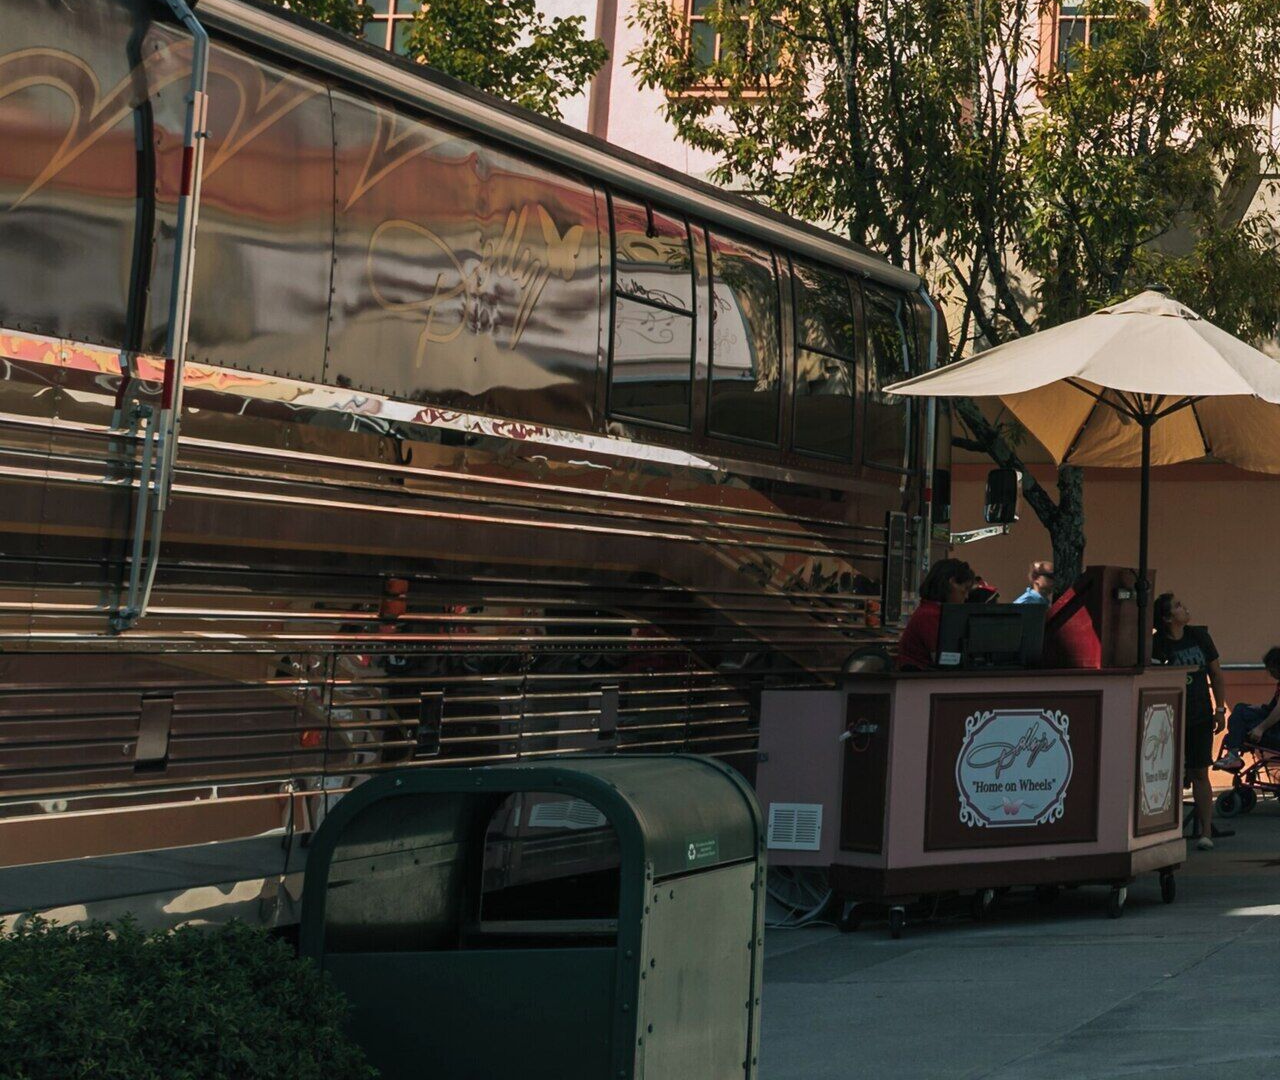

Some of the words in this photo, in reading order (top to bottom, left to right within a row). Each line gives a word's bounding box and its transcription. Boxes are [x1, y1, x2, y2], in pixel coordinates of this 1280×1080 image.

[967, 721, 1056, 779] Dolly's
[972, 781, 1003, 793] "Home
[1005, 782, 1017, 792] on
[1019, 779, 1056, 791] Wheels"
